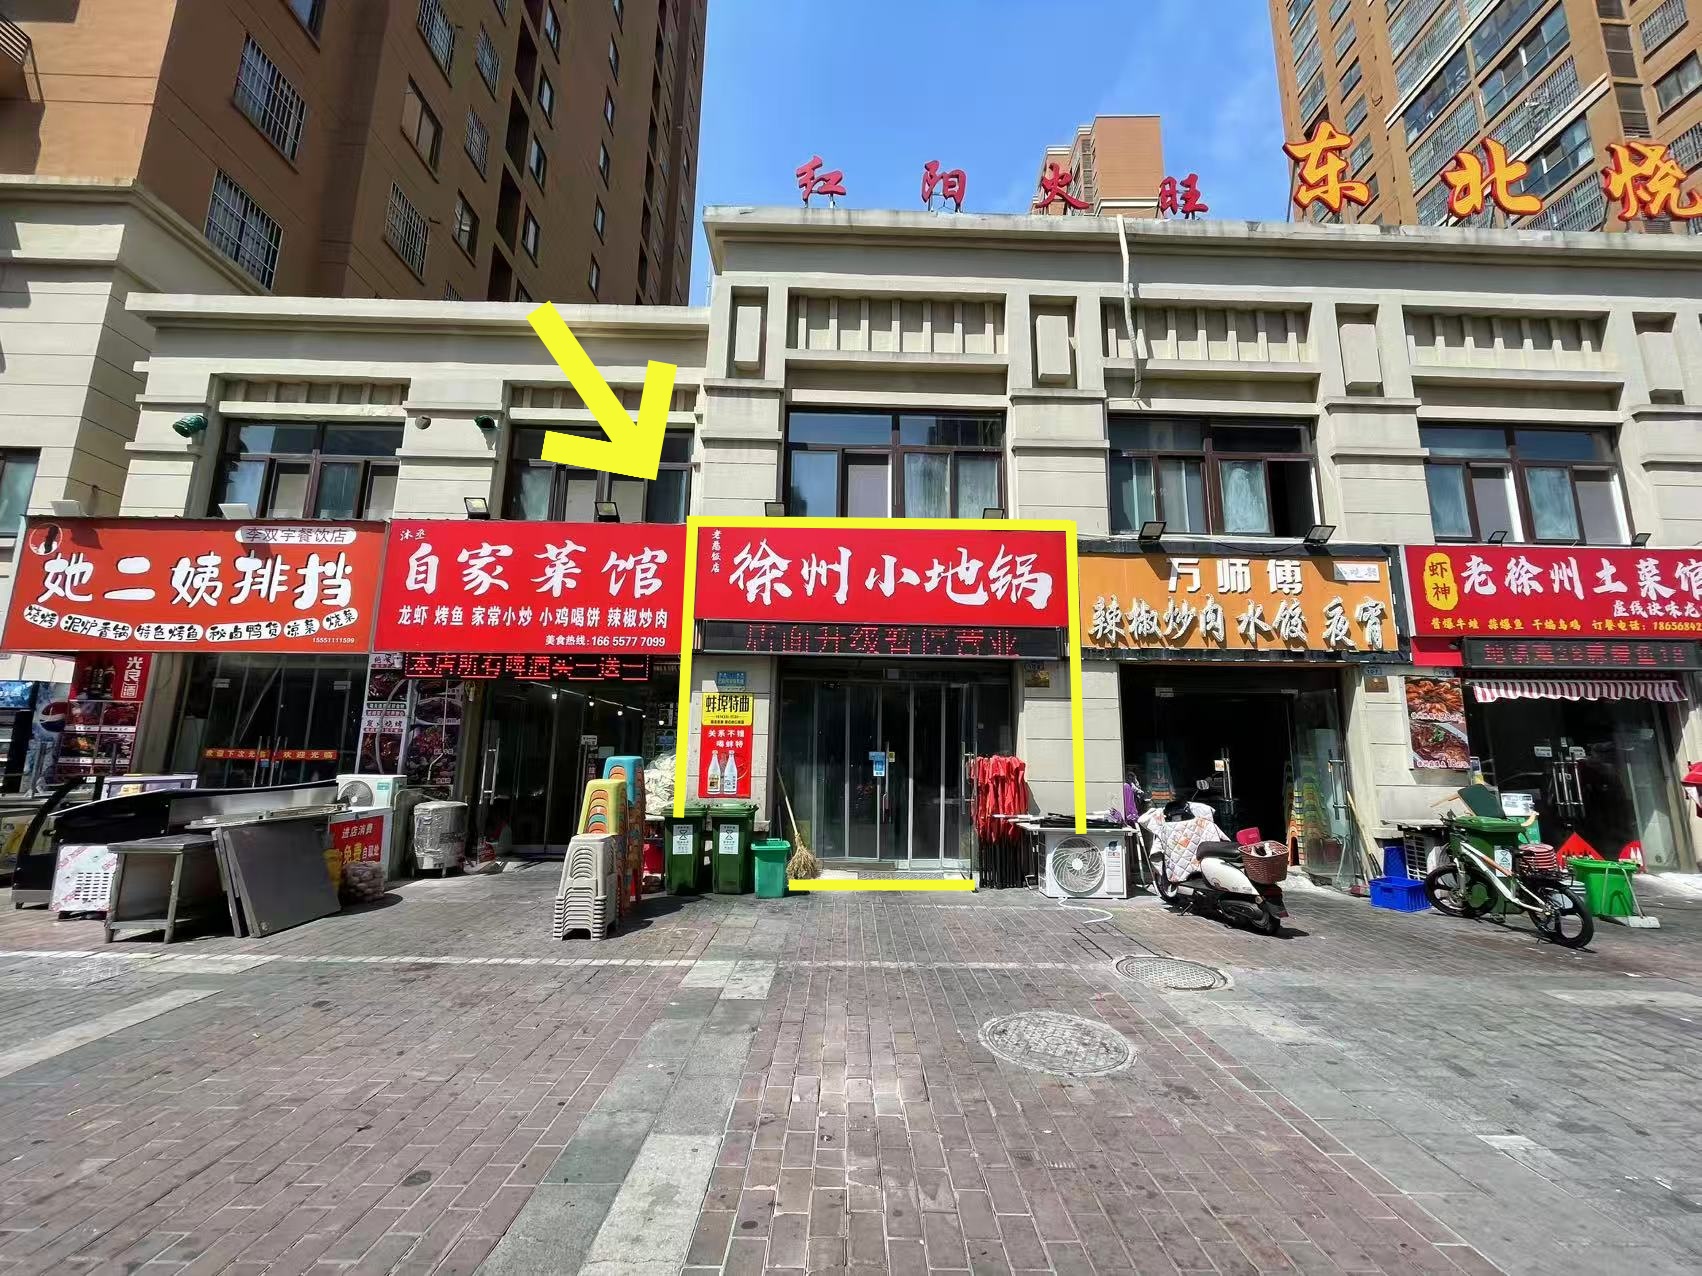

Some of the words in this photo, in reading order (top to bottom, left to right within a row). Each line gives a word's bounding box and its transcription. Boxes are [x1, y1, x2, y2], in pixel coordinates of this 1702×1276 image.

[1283, 119, 1702, 221] 东北烧
[246, 527, 347, 543] 李双宇餐饮店
[37, 551, 354, 611] 她二姨排挡
[404, 539, 669, 599] 自家菜馆
[729, 539, 1053, 609] 徐州小地锅
[1428, 561, 1451, 601] 虾神
[1461, 555, 1702, 601] 老徐州土菜馆
[26, 604, 57, 628] 烧烤
[136, 624, 202, 641] 特色烤鱼
[286, 619, 316, 637] 凉菜
[325, 609, 356, 629] 烧菜
[397, 605, 428, 626] 龙虾
[434, 606, 463, 626] 烤鱼
[471, 606, 533, 627] 家常小炒
[539, 607, 600, 628] 小鸡喝饼
[607, 608, 668, 629] 辣椒炒肉
[1089, 594, 1226, 643] 辣椒炒肉
[1237, 599, 1308, 642] 水饺
[1322, 596, 1386, 649] 夜宵
[591, 636, 610, 646] 166
[612, 636, 637, 647] 5577
[640, 636, 666, 647] 7099
[122, 656, 143, 698] 光良酒
[705, 694, 750, 713] 蚌埠特曲
[283, 751, 334, 760] 欢迎光临
